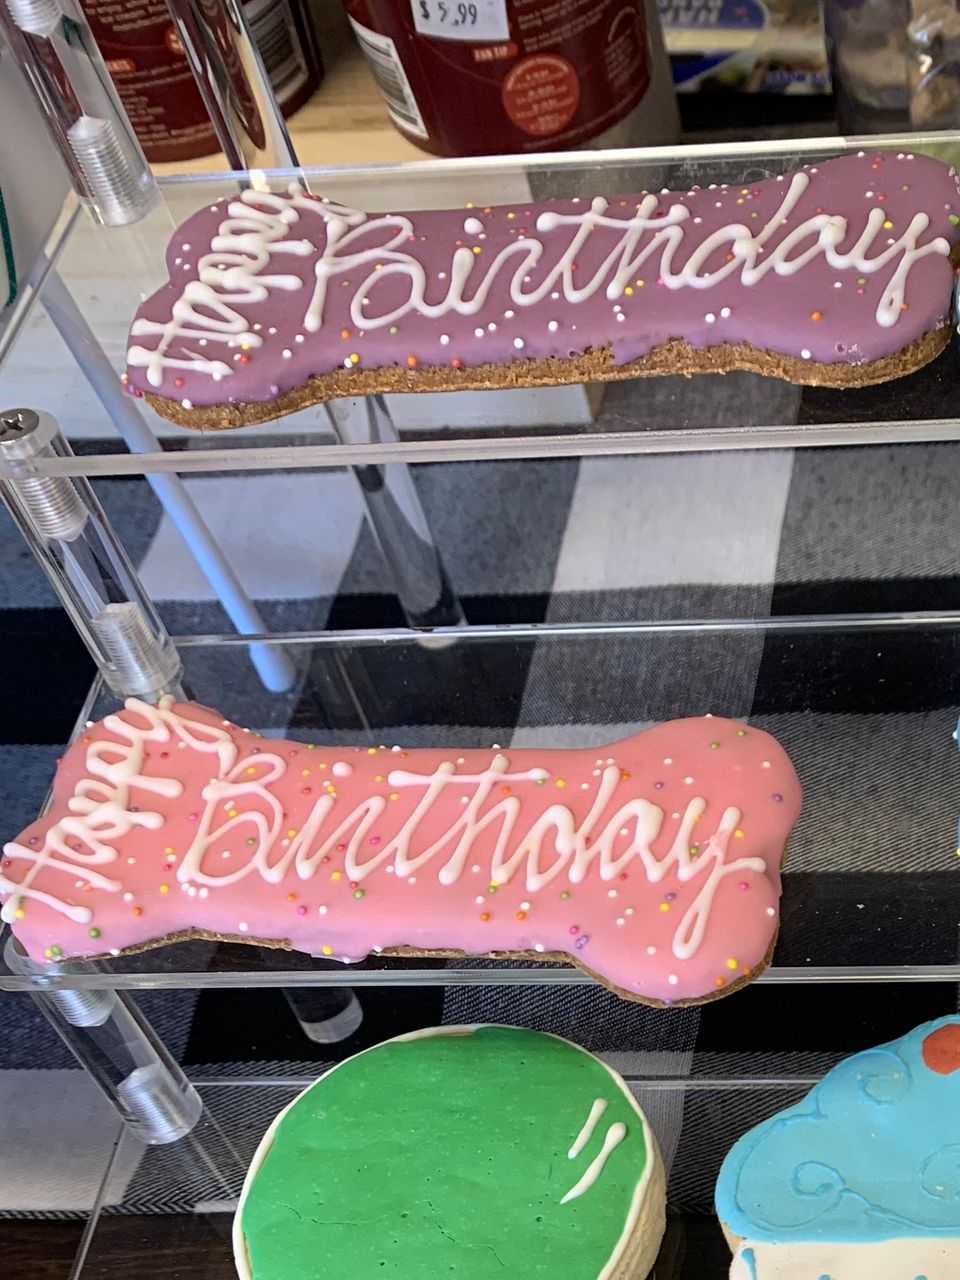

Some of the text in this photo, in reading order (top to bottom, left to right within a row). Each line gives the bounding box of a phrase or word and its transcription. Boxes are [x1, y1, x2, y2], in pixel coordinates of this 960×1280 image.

[127, 182, 366, 387] Happy
[304, 171, 950, 331] Birthday
[0, 695, 238, 925] Happy
[177, 752, 767, 959] Birthday
